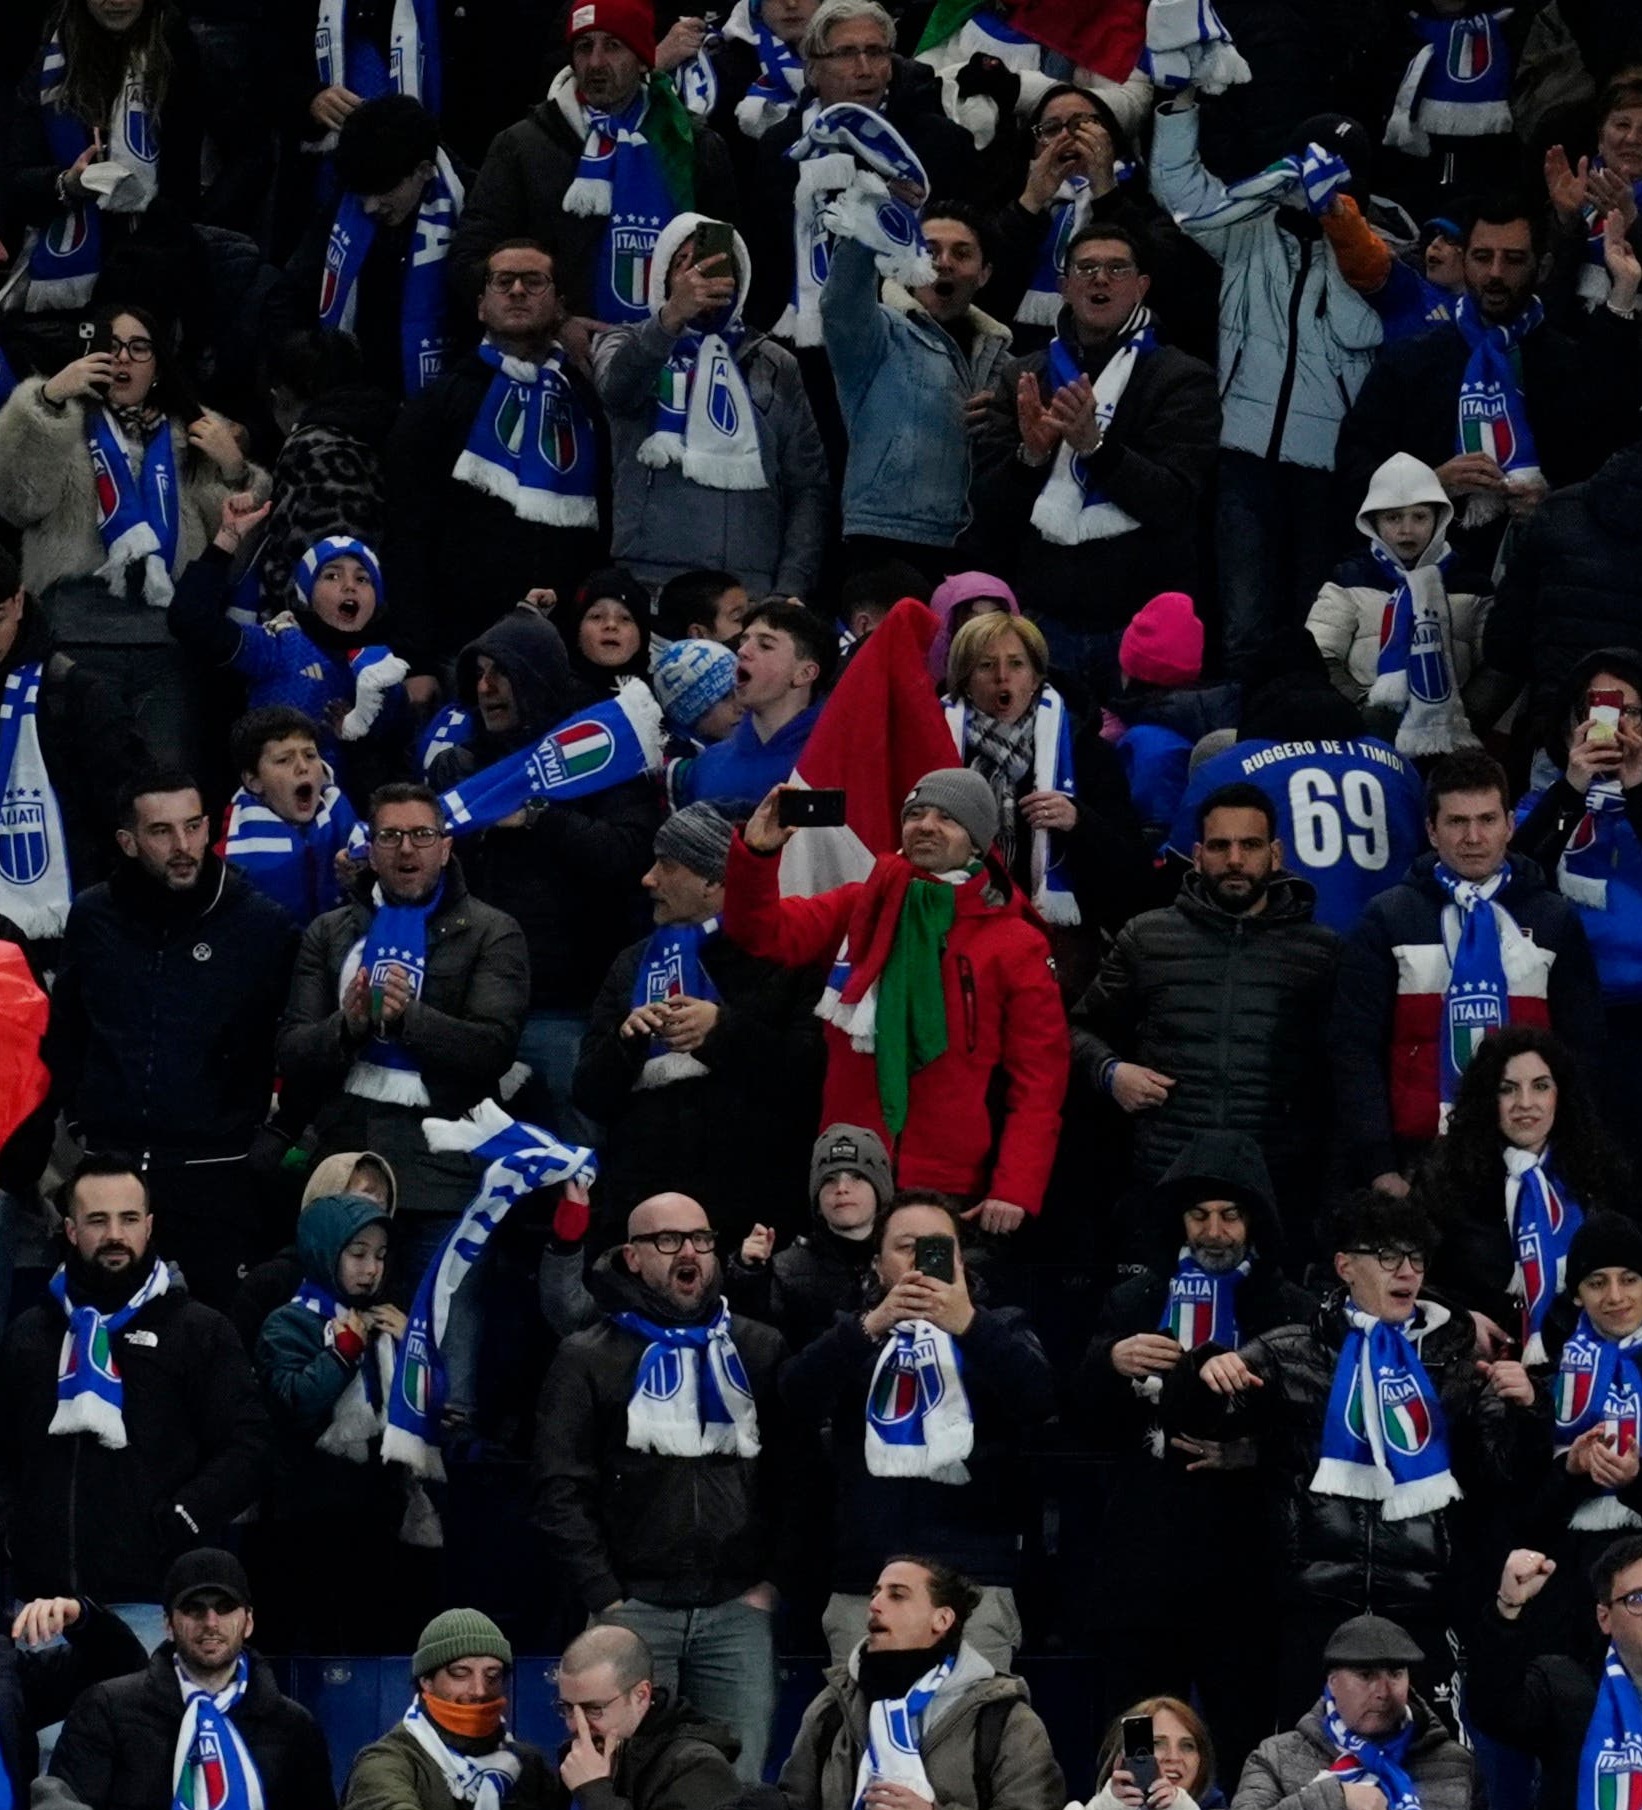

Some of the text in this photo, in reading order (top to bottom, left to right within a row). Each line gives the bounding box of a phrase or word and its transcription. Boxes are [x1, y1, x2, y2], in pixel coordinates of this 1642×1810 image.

[1464, 399, 1505, 417] ITALIA
[539, 736, 570, 784] ITALIA
[1241, 738, 1406, 777] RUGGERO DE I TIMIDI
[1285, 767, 1391, 870] 69
[1453, 1000, 1499, 1020] ITALIA
[1564, 1350, 1594, 1369] ALIA
[1383, 1382, 1415, 1404] ALIA
[1603, 1399, 1635, 1417] ALIA
[1599, 1749, 1642, 1769] ITALIA
